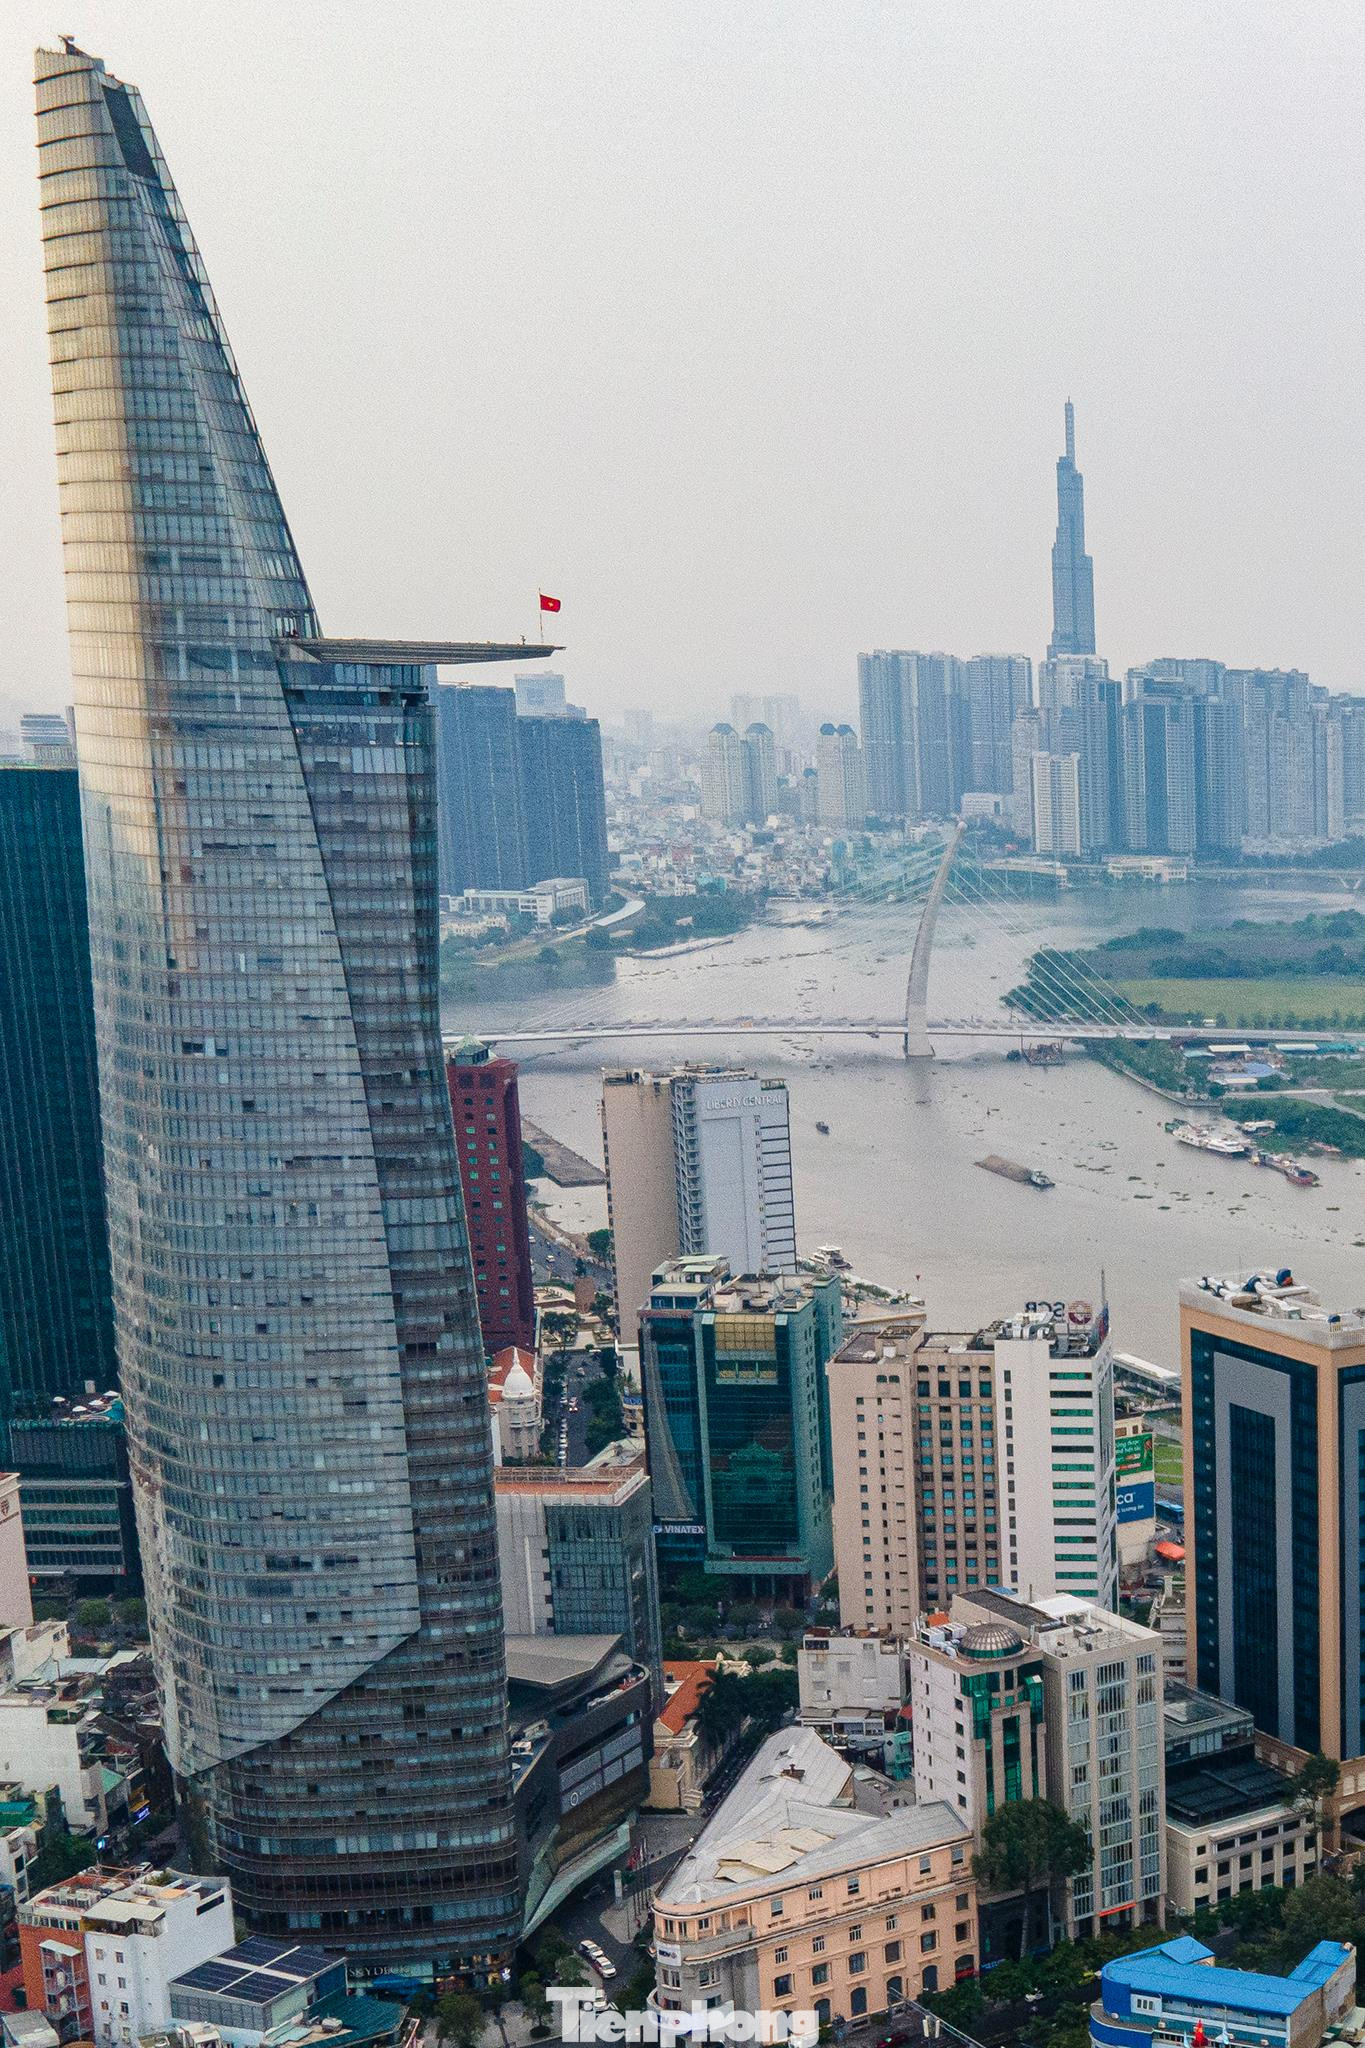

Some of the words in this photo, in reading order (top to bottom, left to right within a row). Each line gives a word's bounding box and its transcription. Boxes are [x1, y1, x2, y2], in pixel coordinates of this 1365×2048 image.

[706, 1097, 741, 1110] LIBERTY
[743, 1095, 785, 1108] CENTRAL
[664, 1525, 705, 1534] VINATEX
